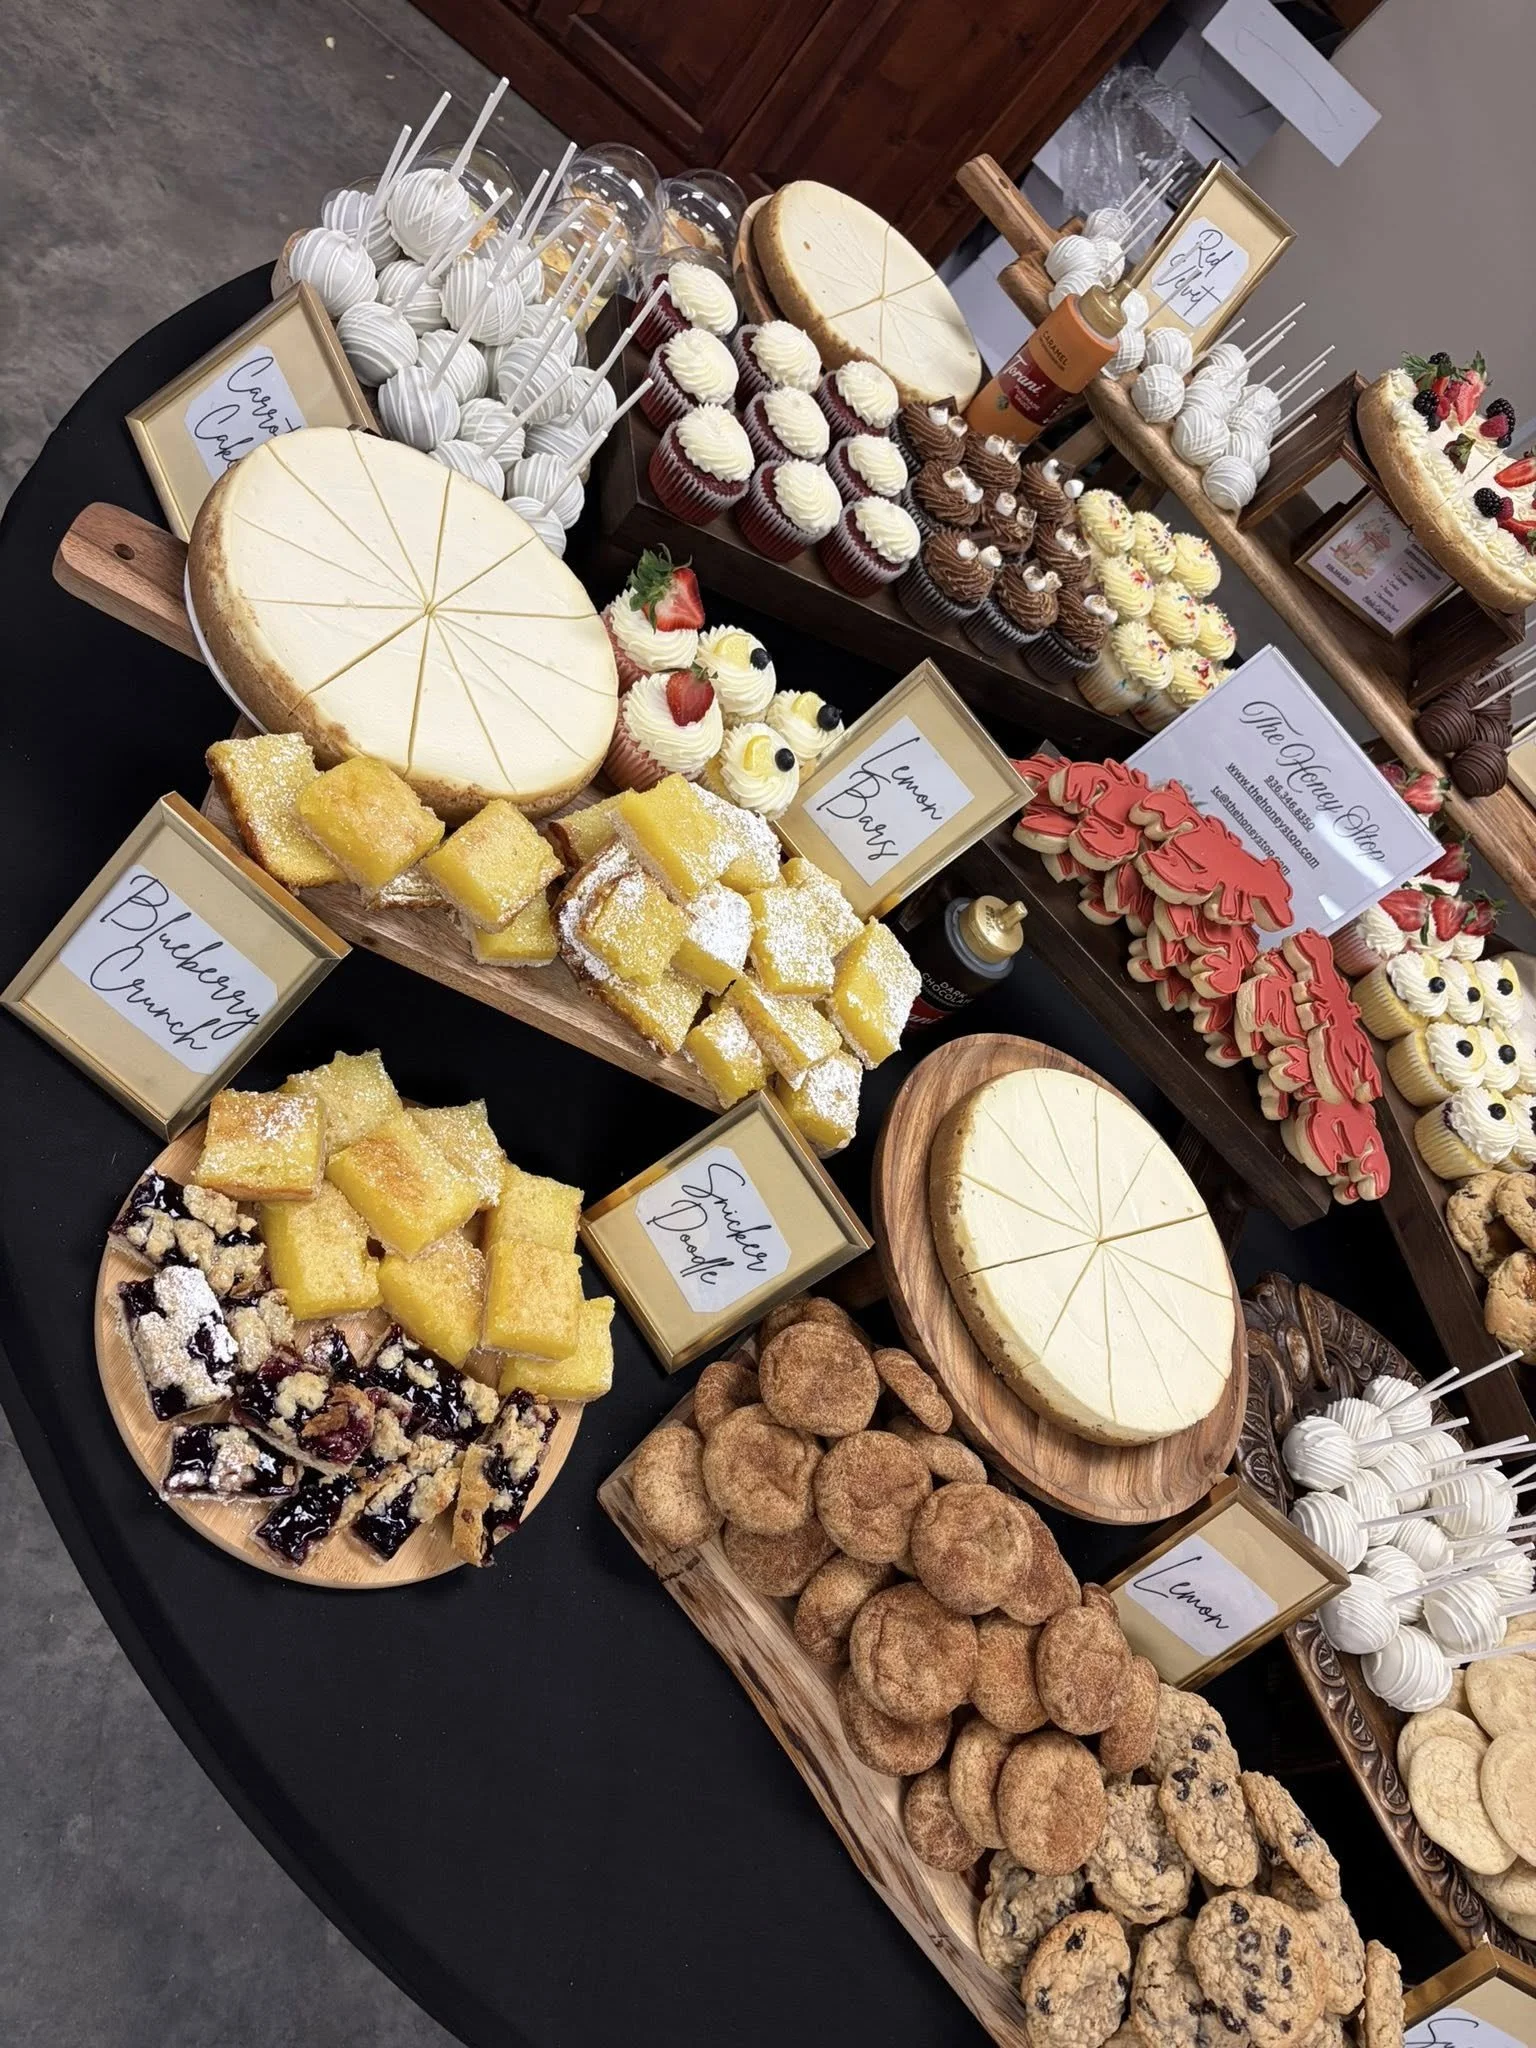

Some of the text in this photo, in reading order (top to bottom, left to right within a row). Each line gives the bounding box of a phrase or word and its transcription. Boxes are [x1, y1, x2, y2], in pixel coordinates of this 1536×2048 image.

[1157, 253, 1222, 316] Velvet
[1198, 229, 1234, 277] Red
[1003, 353, 1046, 394] Torani
[1042, 330, 1069, 366] CARAMEL
[815, 770, 899, 860] Bars
[860, 736, 943, 820] Lemon
[1225, 761, 1320, 869] www.thehoneystop.com
[1238, 700, 1386, 863] The Honey Stop
[1263, 773, 1317, 832] 936.346.8350
[1210, 784, 1291, 877] tc@thehoneystopcom
[90, 945, 208, 1050] Crunch
[99, 874, 260, 1040] Blueberry
[939, 981, 968, 999] DARK
[646, 1199, 735, 1285] Doodle
[681, 1163, 773, 1272] Snicker
[1133, 1555, 1230, 1630] Lemon
